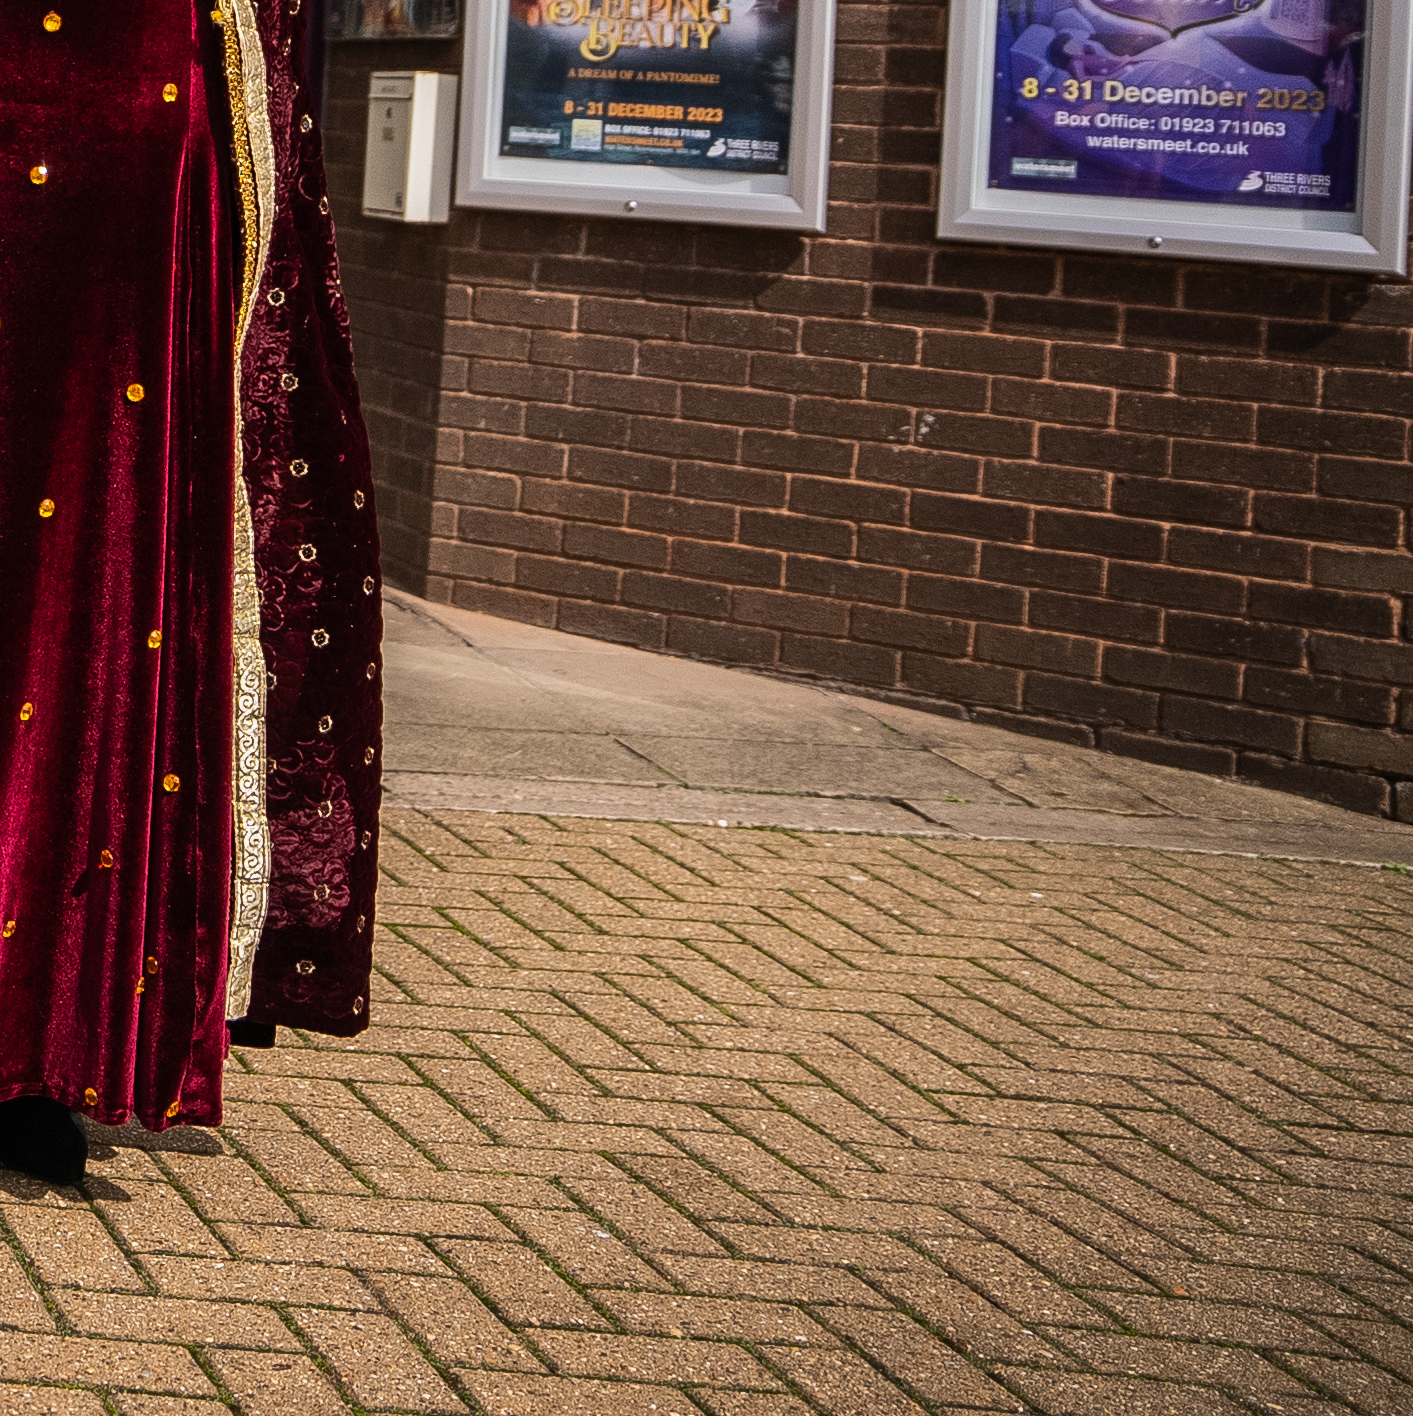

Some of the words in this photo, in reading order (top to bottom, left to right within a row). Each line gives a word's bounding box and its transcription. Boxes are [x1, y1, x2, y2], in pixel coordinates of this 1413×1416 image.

[579, 18, 718, 62] BEAUTY
[578, 68, 617, 79] DREAM
[619, 70, 634, 80] OF
[1022, 77, 1038, 98] 8
[1062, 80, 1093, 100] 31
[1102, 80, 1247, 108] December
[1256, 88, 1326, 111] 2023
[564, 100, 574, 115] 8
[586, 102, 604, 116] 31
[608, 102, 684, 120] DECEMBER
[687, 106, 723, 122] 2023
[1054, 111, 1090, 128] Box
[1094, 113, 1156, 131] Office:
[1160, 117, 1215, 134] 01923
[1219, 120, 1287, 136] 711063
[1086, 135, 1250, 156] watersmeet.co.uk
[1265, 172, 1295, 184] THREE
[1296, 173, 1331, 186] RIVERS
